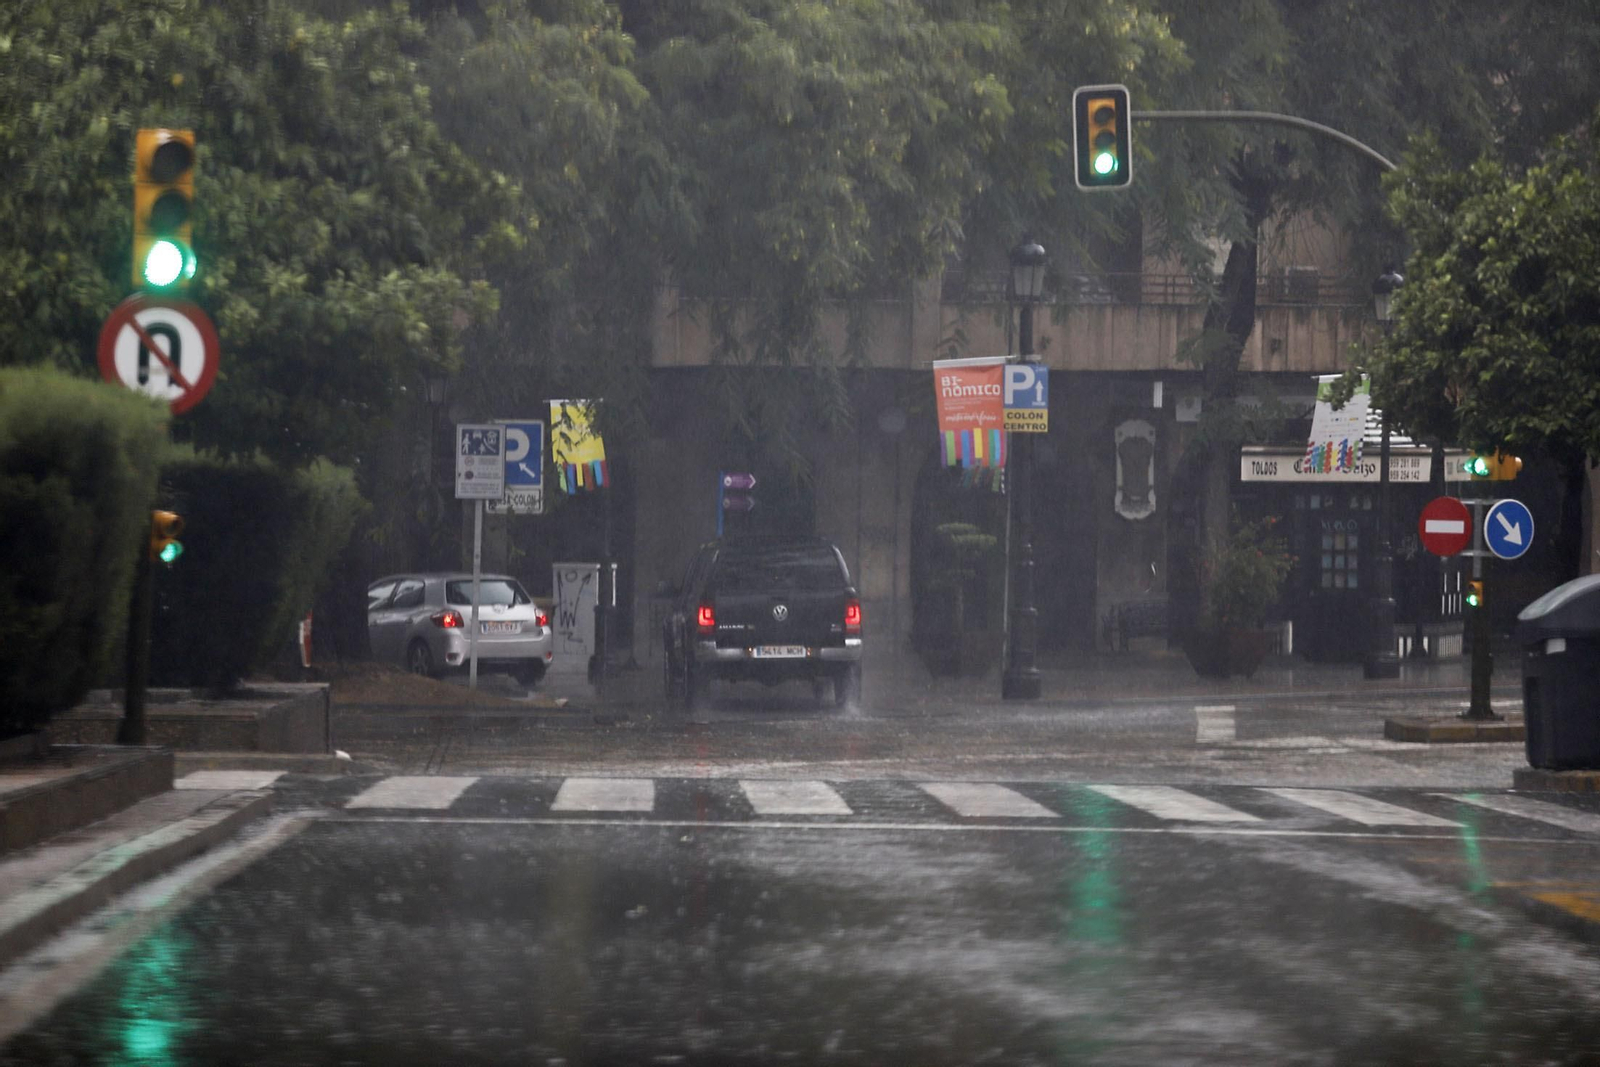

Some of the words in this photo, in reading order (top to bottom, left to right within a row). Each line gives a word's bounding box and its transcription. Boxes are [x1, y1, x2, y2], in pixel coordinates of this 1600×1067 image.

[1004, 365, 1036, 405] P
[1003, 422, 1047, 431] CENTRO
[1251, 461, 1278, 476] TOLDOS
